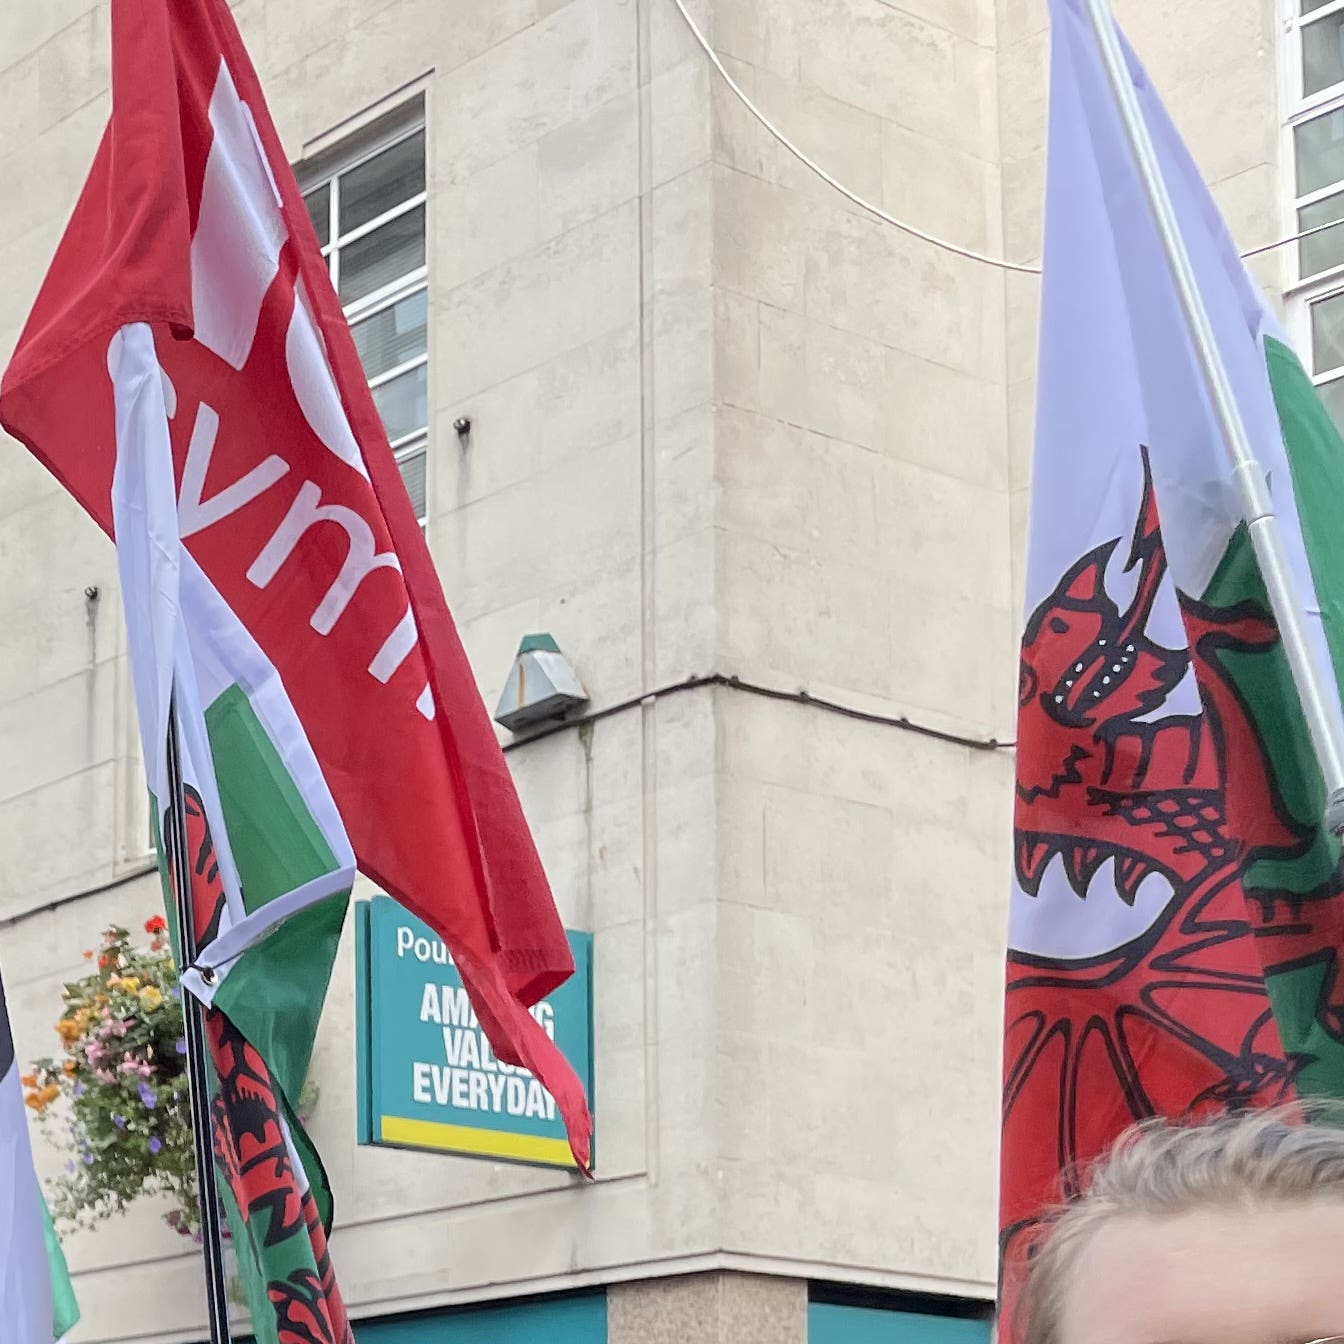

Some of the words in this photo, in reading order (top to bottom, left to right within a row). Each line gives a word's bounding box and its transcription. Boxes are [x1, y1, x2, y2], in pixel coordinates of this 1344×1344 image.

[396, 926, 455, 966] Pou
[442, 1025, 533, 1077] VAL
[413, 1061, 556, 1121] EVERYDAY
